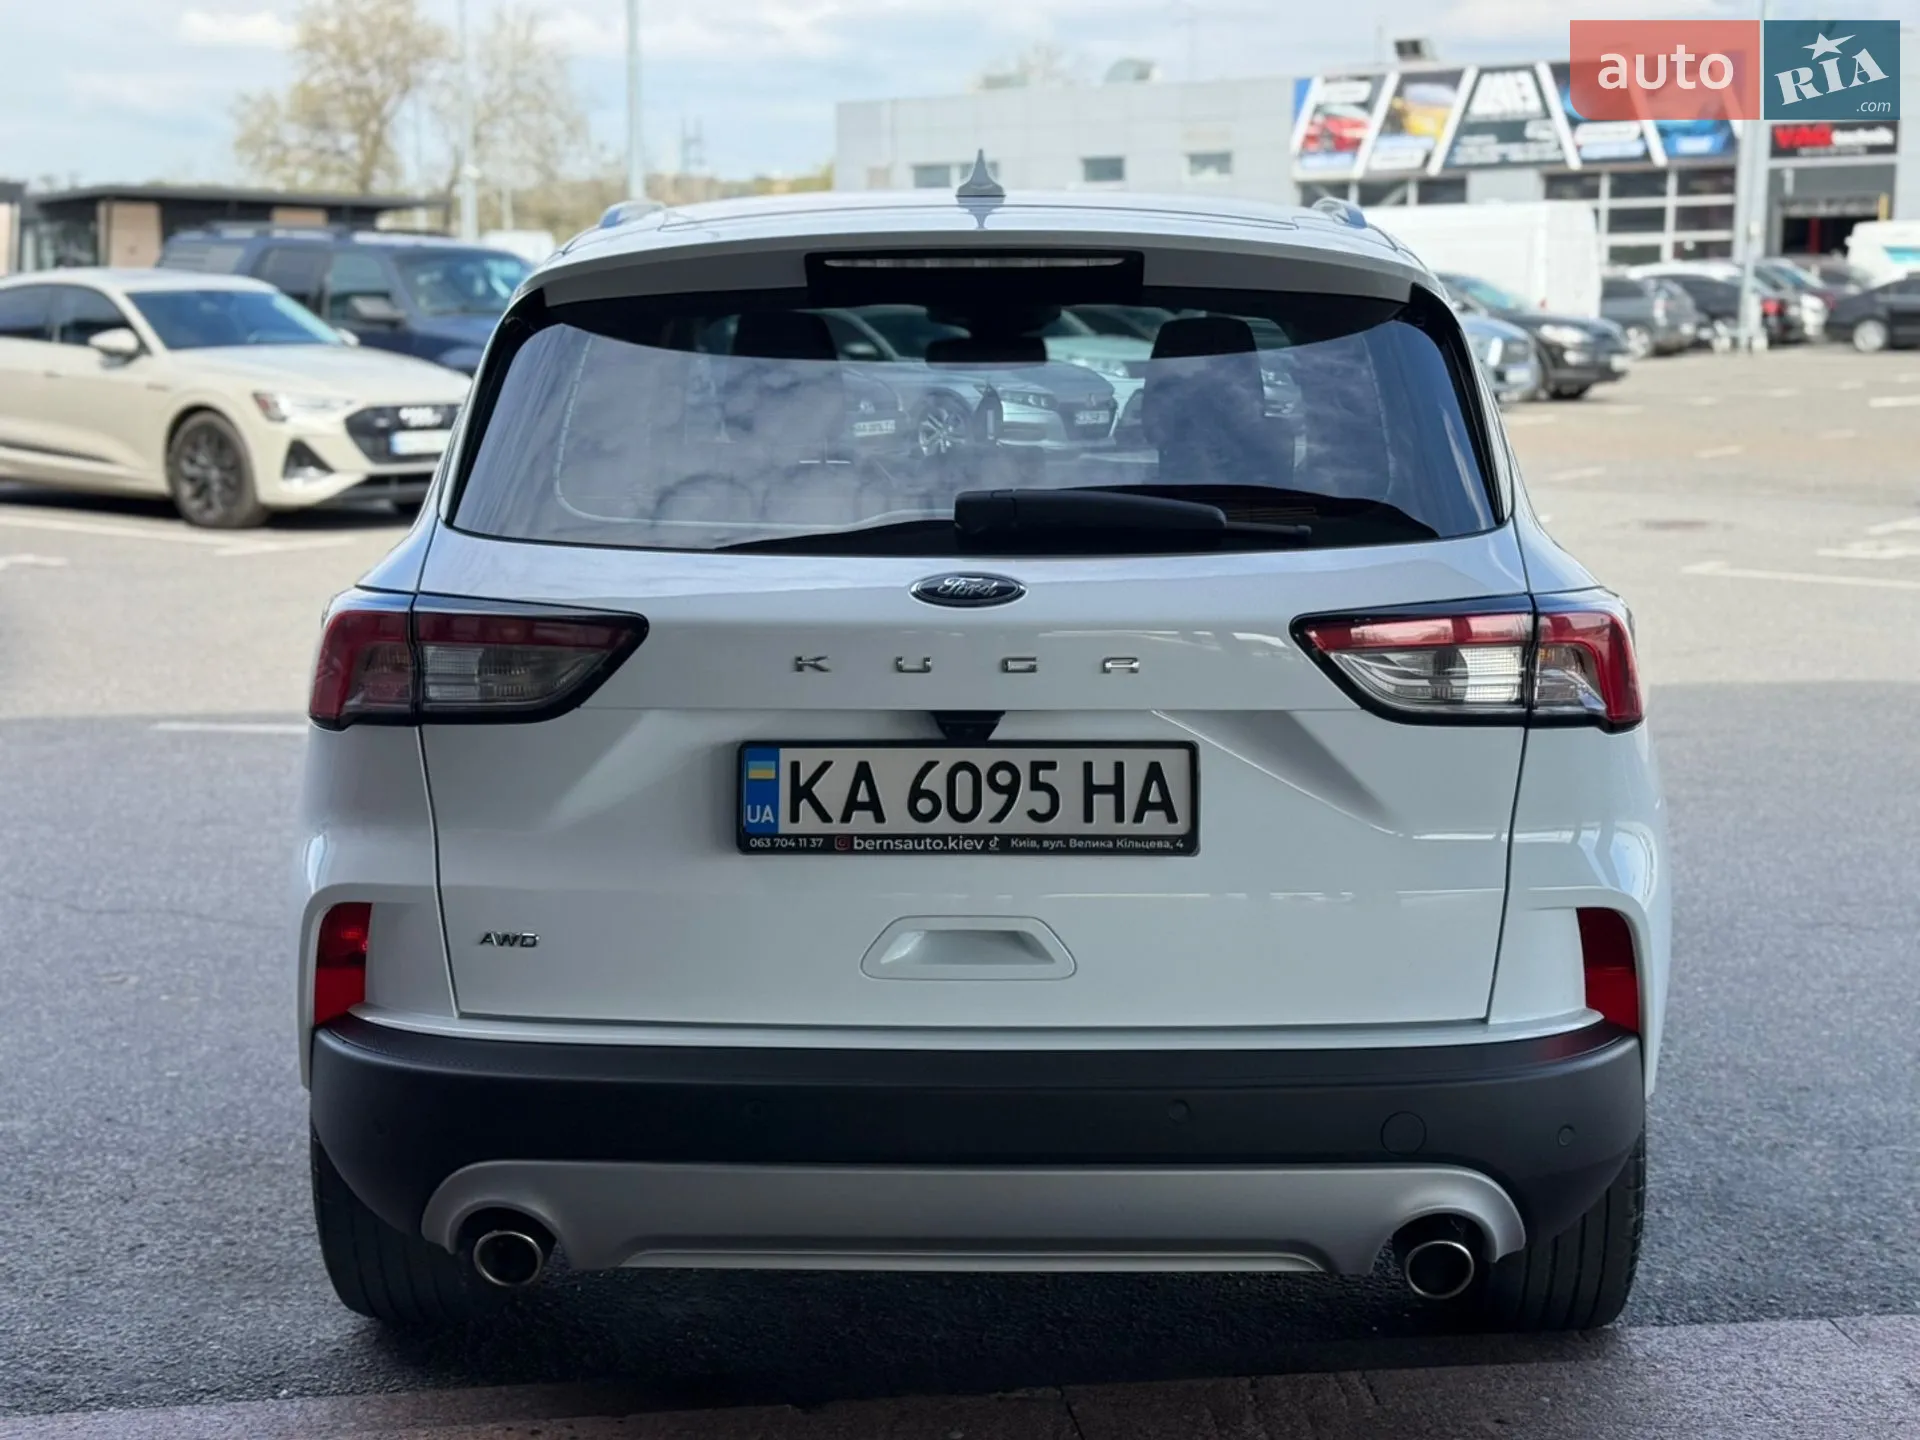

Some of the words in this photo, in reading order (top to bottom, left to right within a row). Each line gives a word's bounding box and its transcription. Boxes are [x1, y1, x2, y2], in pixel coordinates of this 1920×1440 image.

[937, 577, 998, 596] Ford
[794, 656, 1140, 674] KUGA
[790, 760, 886, 823] KA
[907, 760, 1060, 823] 6095
[1083, 760, 1179, 823] HA
[746, 804, 775, 823] UA
[749, 837, 771, 848] 063
[774, 837, 796, 848] 704
[799, 837, 807, 848] 11
[809, 837, 824, 848] 37
[853, 835, 985, 850] bernsauto.kiev
[1010, 837, 1040, 849] Київ,
[1042, 840, 1066, 850] вул.
[1069, 838, 1114, 849] Велика
[1116, 837, 1173, 850] Кільцева,
[1176, 838, 1184, 849] 4
[479, 932, 540, 948] AWD
